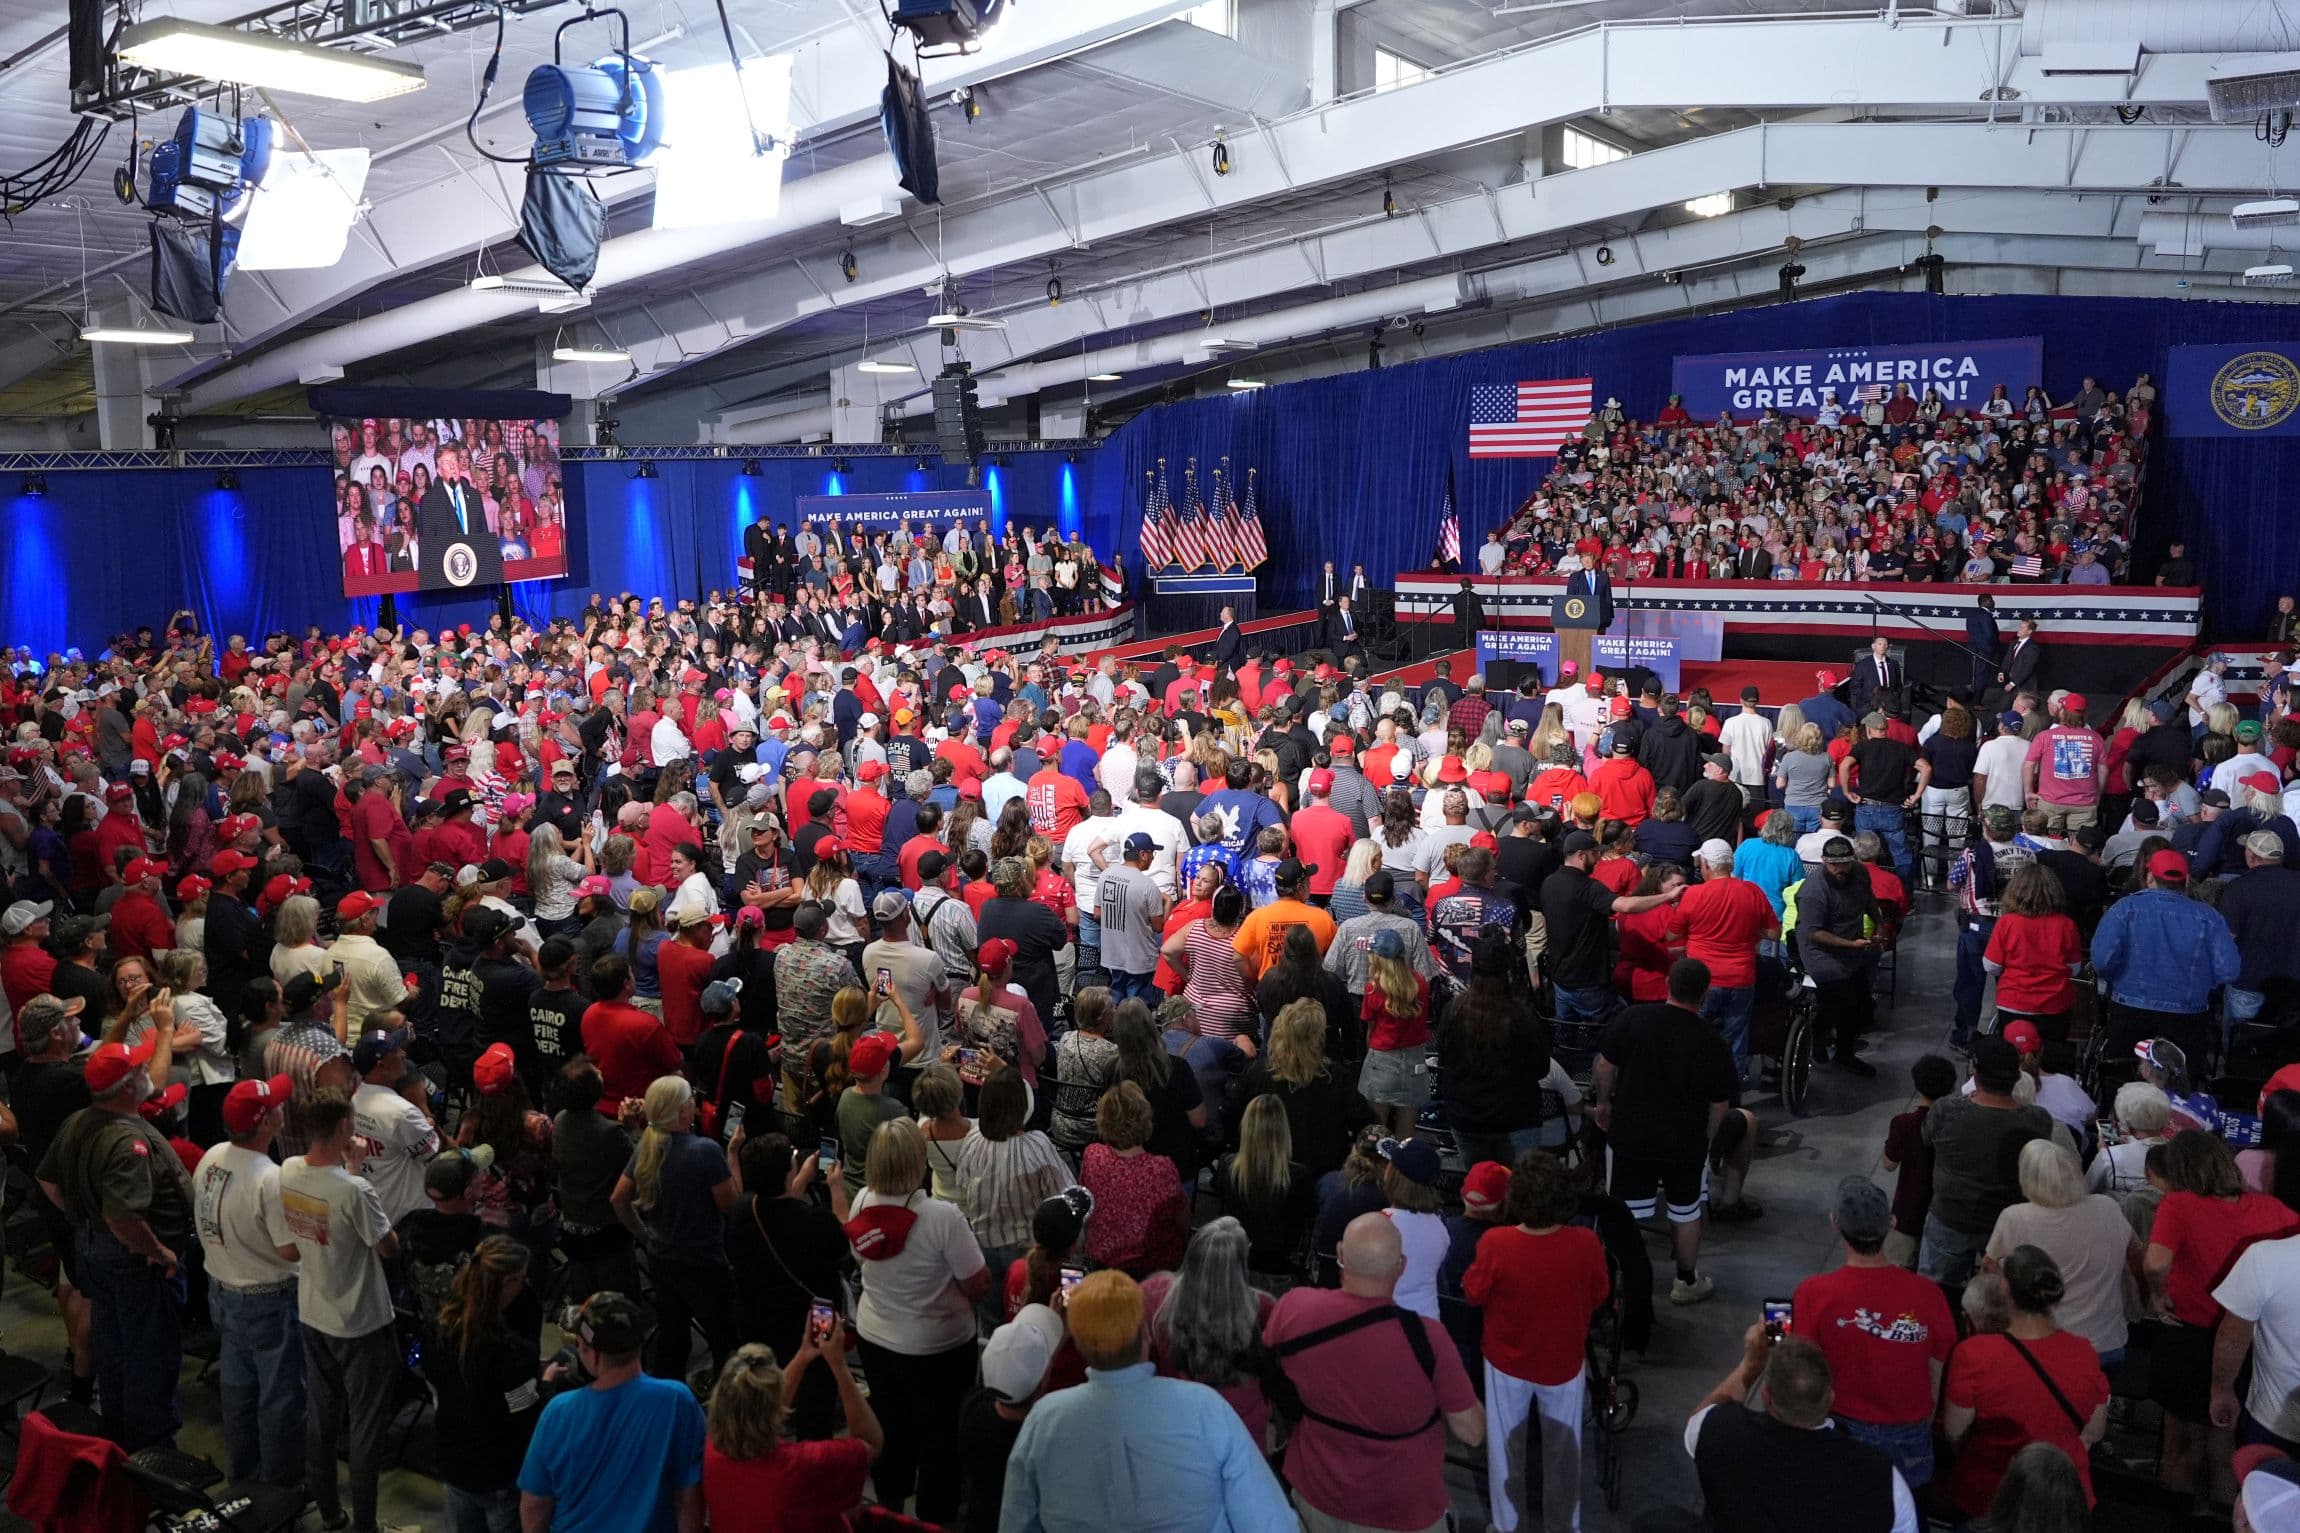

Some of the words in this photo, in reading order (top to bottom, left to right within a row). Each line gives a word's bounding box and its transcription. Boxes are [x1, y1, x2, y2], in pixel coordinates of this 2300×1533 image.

[1725, 365, 1812, 388] MAKE
[1824, 356, 1979, 384] AMERICA
[1733, 386, 1836, 409] GREAT
[808, 513, 842, 523] MAKE
[846, 511, 899, 521] AMERICA
[903, 509, 940, 519] GREAT
[944, 507, 983, 518] AGAIN!
[1482, 634, 1507, 642] MAKE
[1510, 635, 1552, 644] AMERICA
[1484, 642, 1514, 650] GREAT
[1517, 643, 1550, 652] AGAIN!
[1597, 639, 1626, 647] MAKE
[1629, 640, 1673, 649] AMERICA
[1601, 647, 1632, 655] GREAT
[1635, 648, 1671, 657] AGAIN!
[443, 979, 469, 996] FIRE
[530, 1007, 566, 1027] CAIRO
[533, 1023, 560, 1041] FIRE
